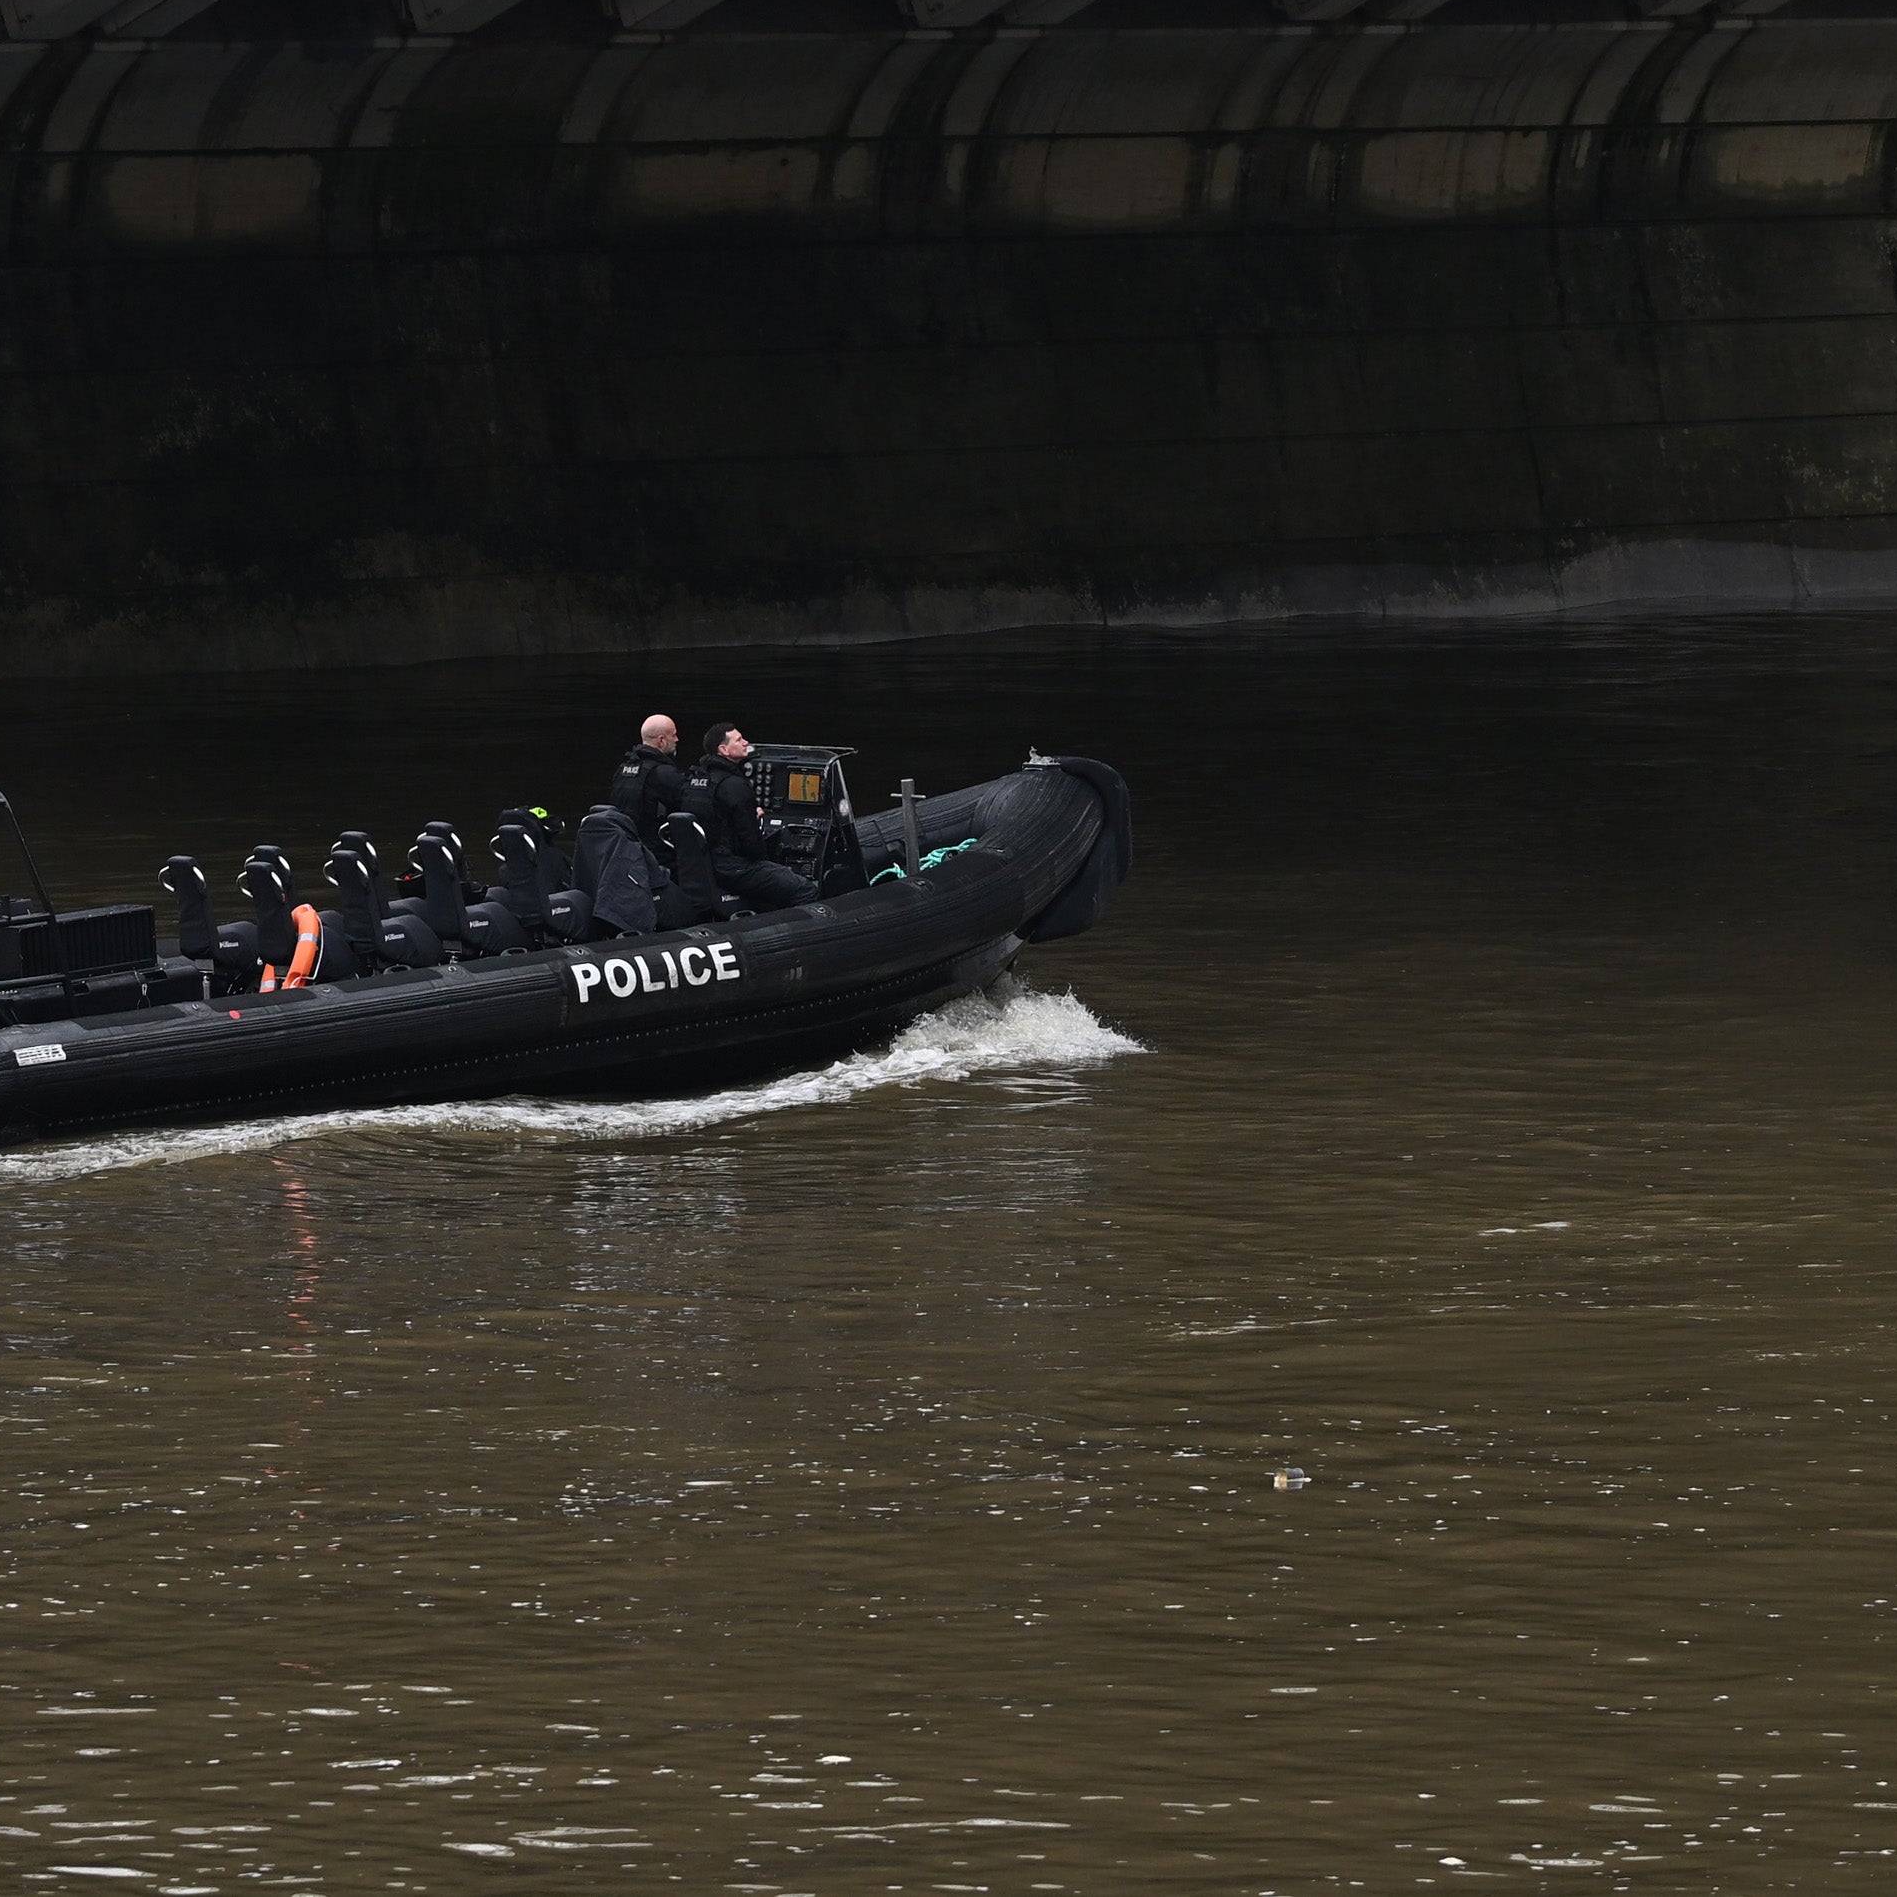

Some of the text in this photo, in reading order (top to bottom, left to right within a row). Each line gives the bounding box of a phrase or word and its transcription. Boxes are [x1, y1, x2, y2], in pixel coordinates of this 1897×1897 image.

[622, 765, 640, 774] POLICE
[690, 778, 708, 787] POLICE
[570, 941, 741, 1003] POLICE
